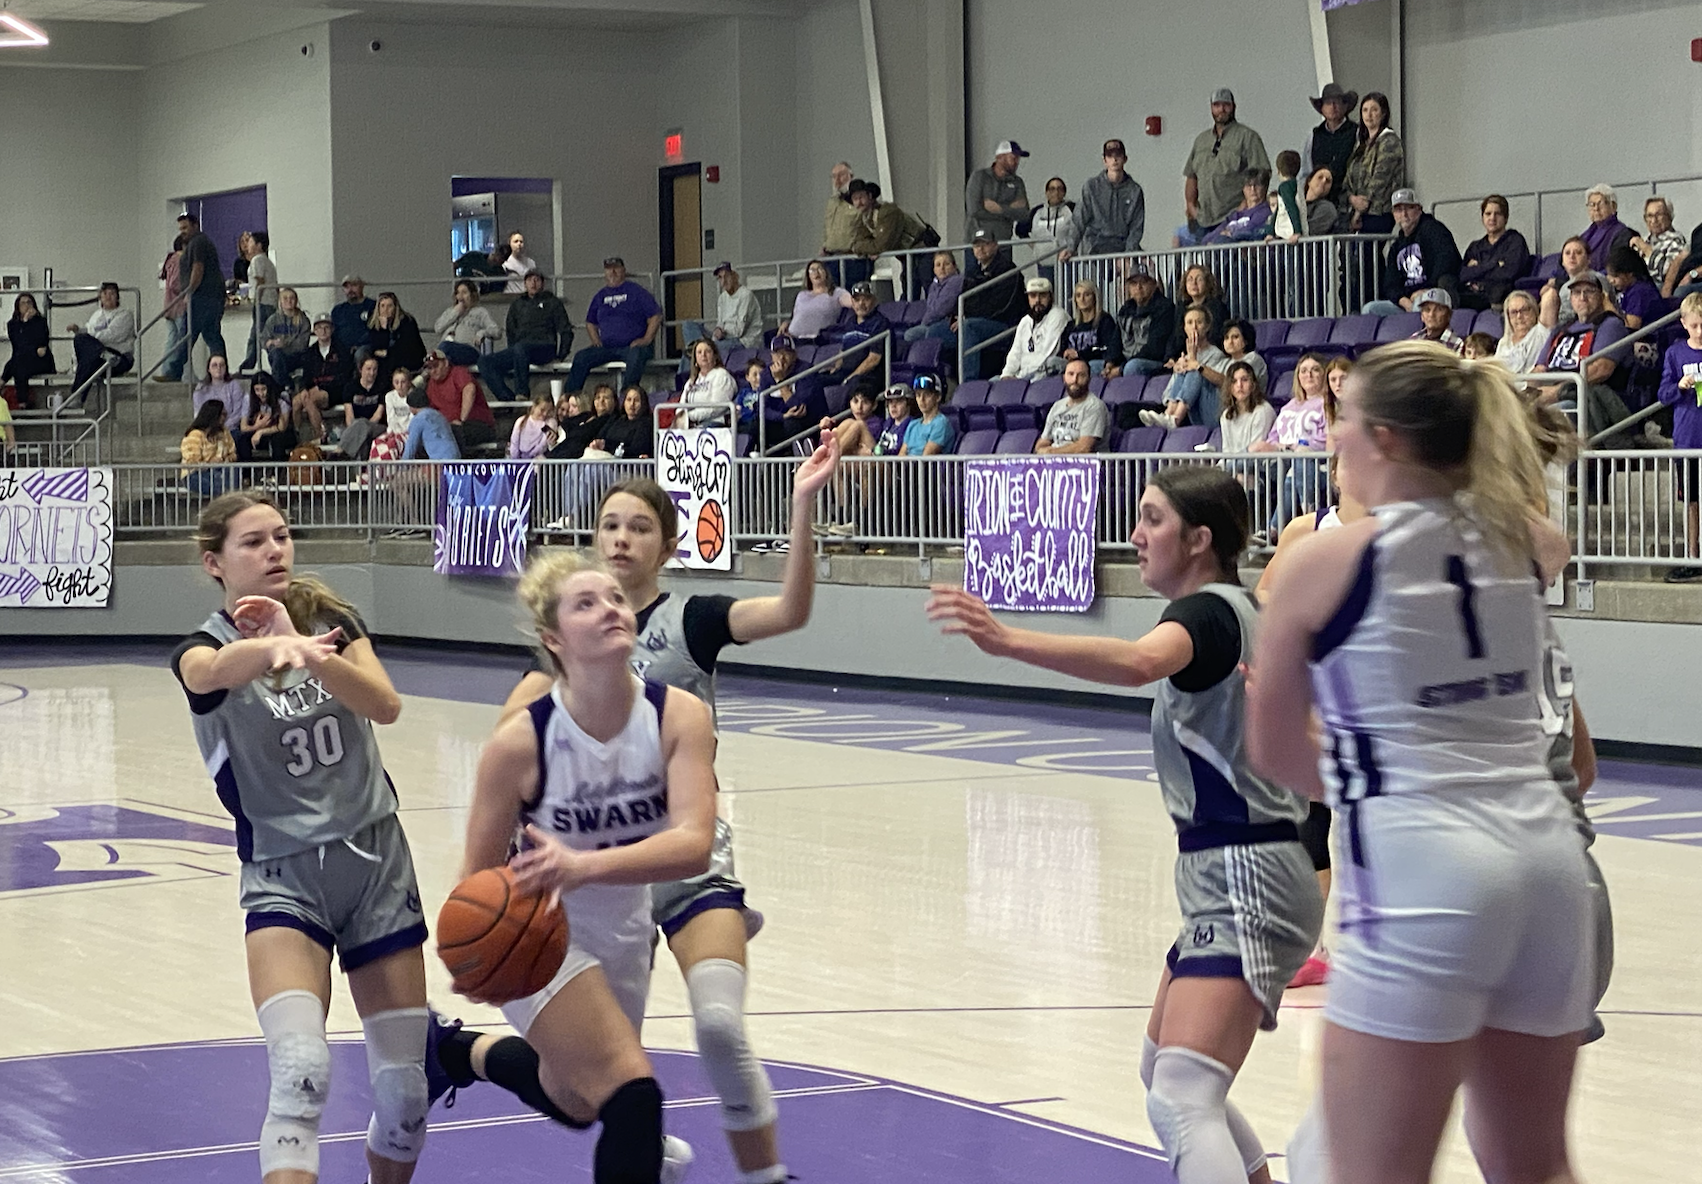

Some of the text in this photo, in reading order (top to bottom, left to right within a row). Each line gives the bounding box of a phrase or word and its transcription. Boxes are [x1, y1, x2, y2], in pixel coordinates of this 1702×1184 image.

[967, 469, 1011, 536] IRION
[1024, 468, 1092, 531] COUNTY
[0, 504, 100, 564] ORNETS
[42, 566, 100, 604] fight
[967, 530, 1089, 603] Basketball
[264, 677, 333, 719] MTX
[281, 715, 344, 777] 30
